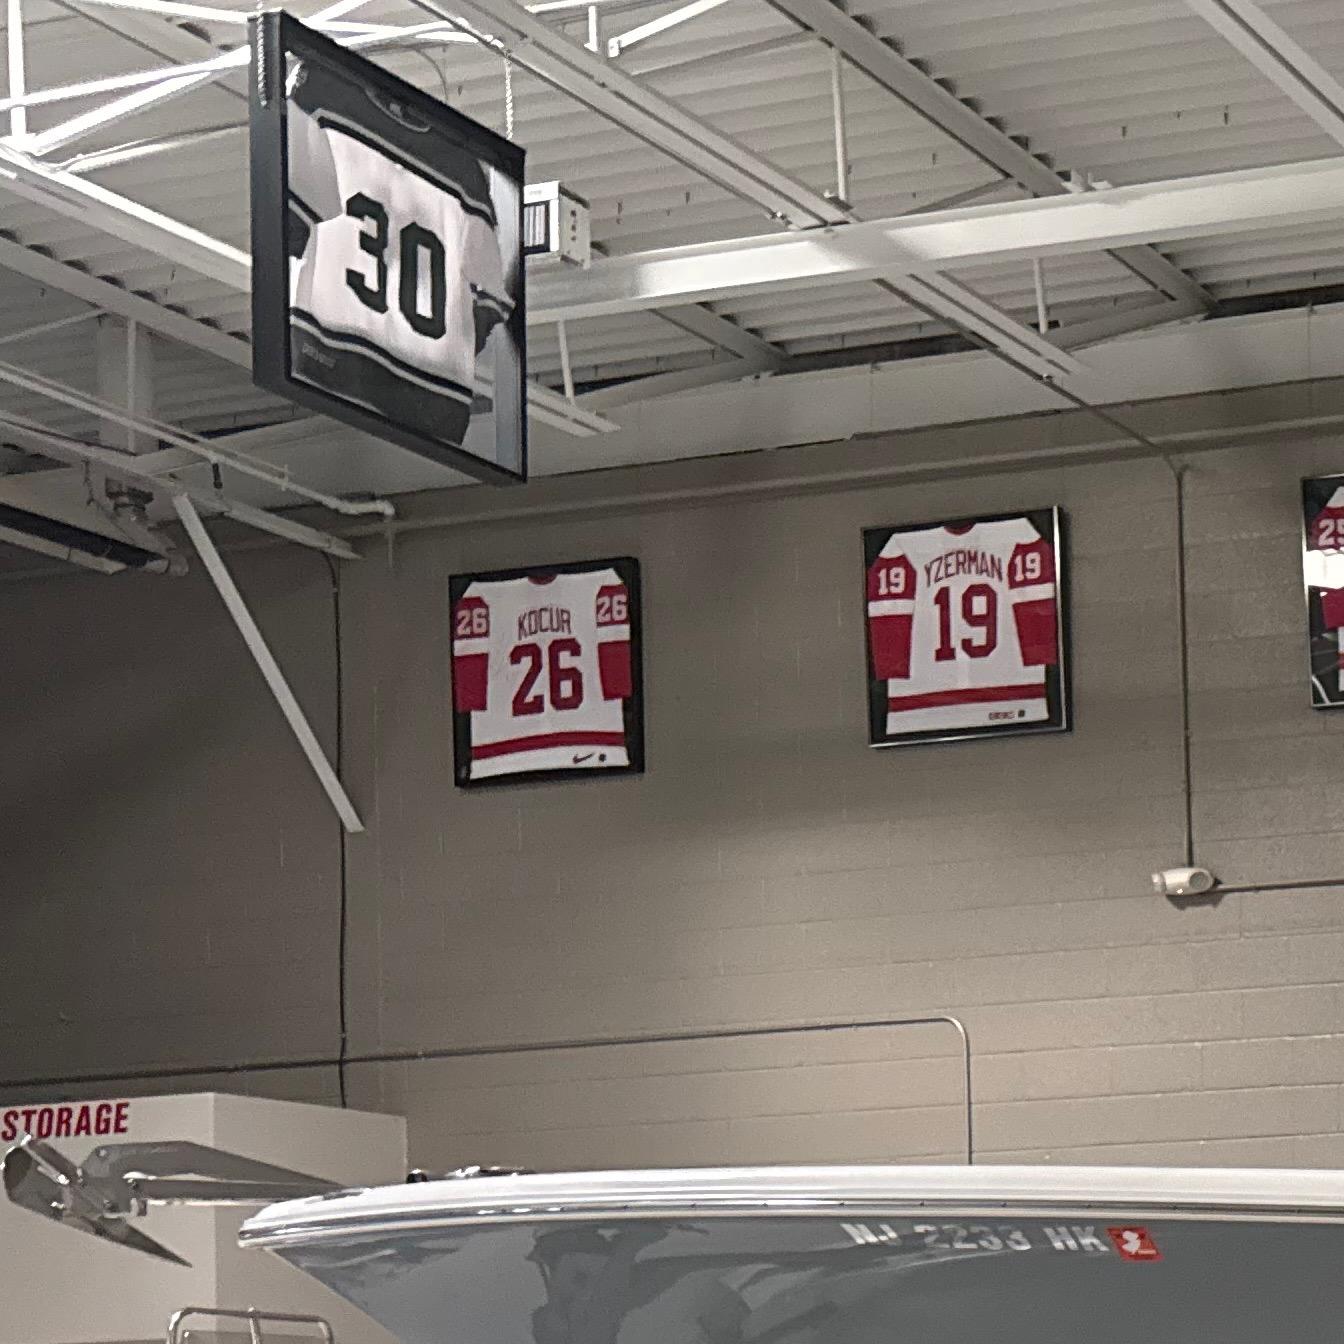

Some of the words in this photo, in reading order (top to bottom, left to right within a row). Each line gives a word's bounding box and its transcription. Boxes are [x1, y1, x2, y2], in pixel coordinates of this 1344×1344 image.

[346, 192, 446, 340] 30
[878, 566, 906, 596] 19
[924, 550, 1003, 588] YZERMAN
[1014, 551, 1042, 582] 19
[456, 607, 490, 637] 26
[518, 607, 572, 641] KOCUR
[597, 593, 627, 622] 26
[934, 583, 998, 662] 19
[509, 637, 584, 717] 26
[1, 1101, 130, 1142] STORAGE
